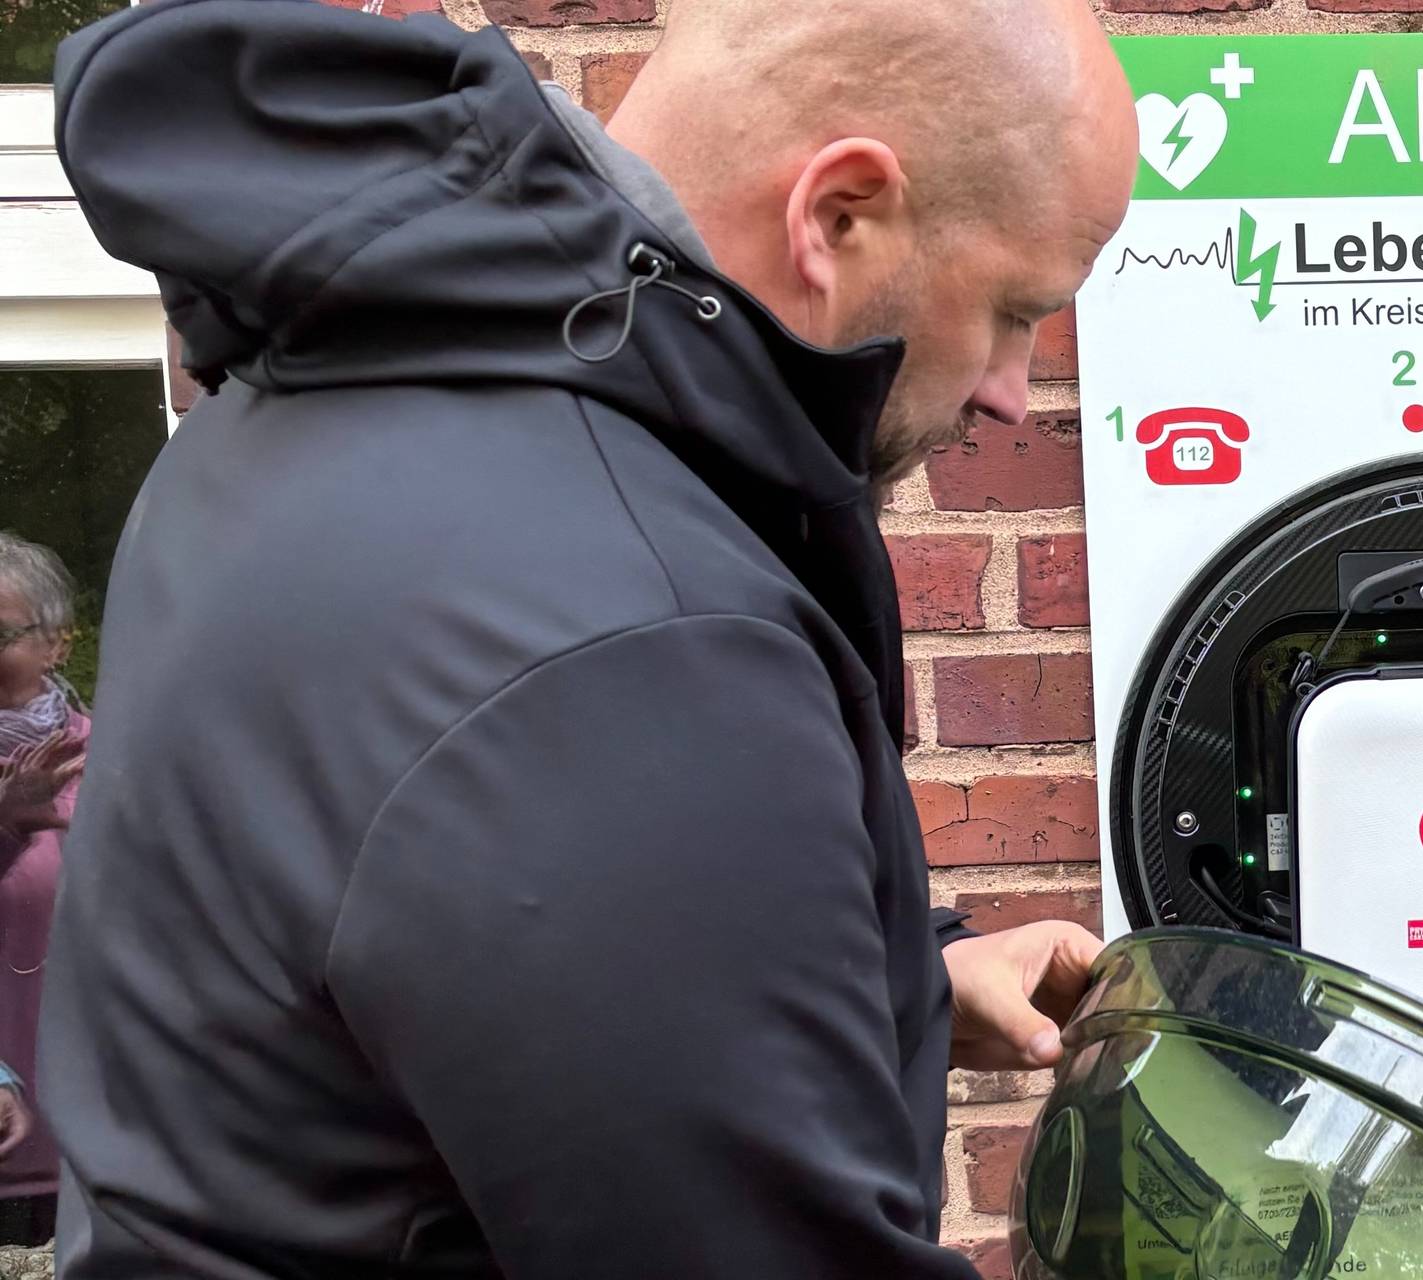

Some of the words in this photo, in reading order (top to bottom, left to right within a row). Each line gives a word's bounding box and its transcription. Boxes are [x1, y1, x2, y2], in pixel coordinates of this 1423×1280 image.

[1303, 298, 1339, 327] im
[1391, 351, 1417, 387] 2
[1105, 405, 1124, 442] 1
[1176, 446, 1211, 462] 112
